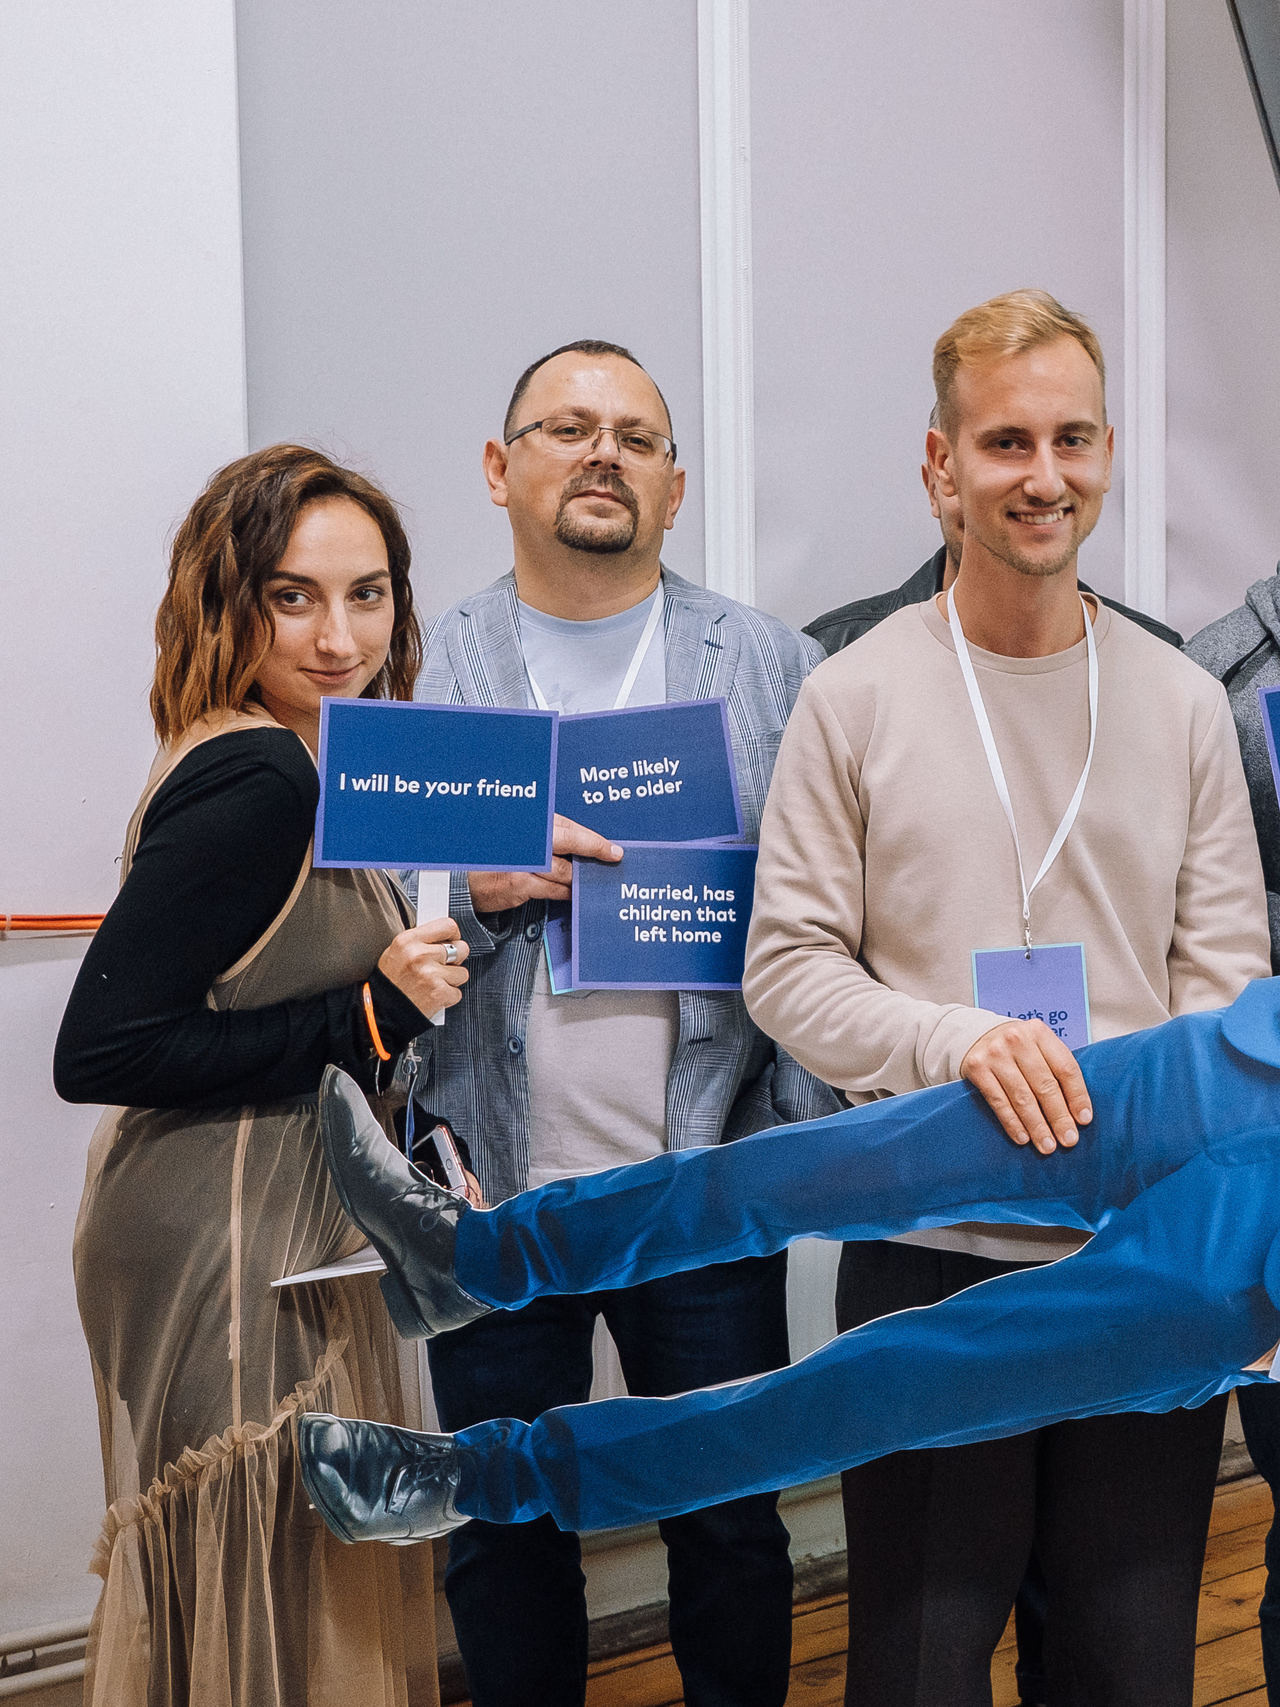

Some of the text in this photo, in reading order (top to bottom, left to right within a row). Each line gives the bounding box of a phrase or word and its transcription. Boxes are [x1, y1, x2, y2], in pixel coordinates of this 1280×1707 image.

[579, 757, 680, 784] More likely
[340, 772, 537, 798] I will be your friend
[582, 778, 683, 805] to be older
[620, 883, 735, 904] Married, has
[618, 904, 737, 922] children that
[634, 925, 722, 943] left home
[1049, 1011, 1068, 1025] go
